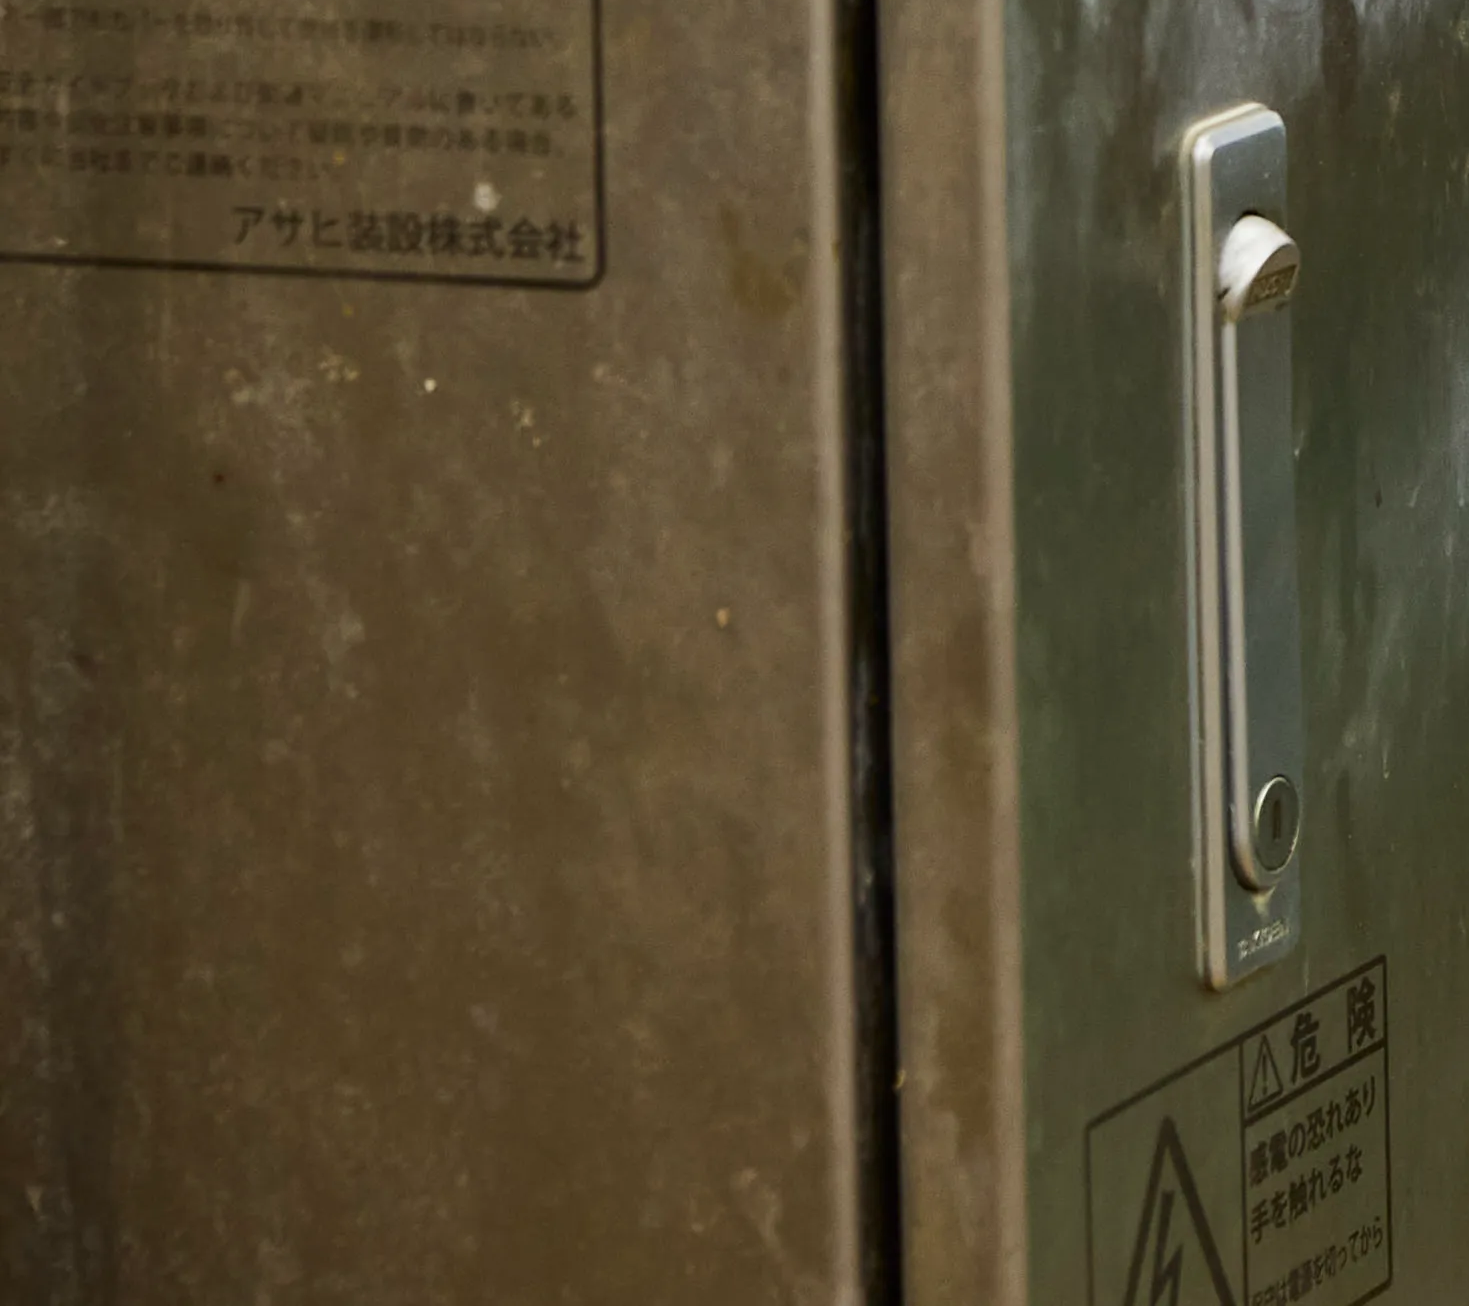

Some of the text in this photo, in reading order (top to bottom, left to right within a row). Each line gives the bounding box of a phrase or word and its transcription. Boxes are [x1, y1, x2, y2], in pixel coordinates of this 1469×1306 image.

[1290, 975, 1378, 1087] 危険
[1249, 1075, 1378, 1188] 感電の恐れあり
[1250, 1146, 1364, 1246] 手を触れるな
